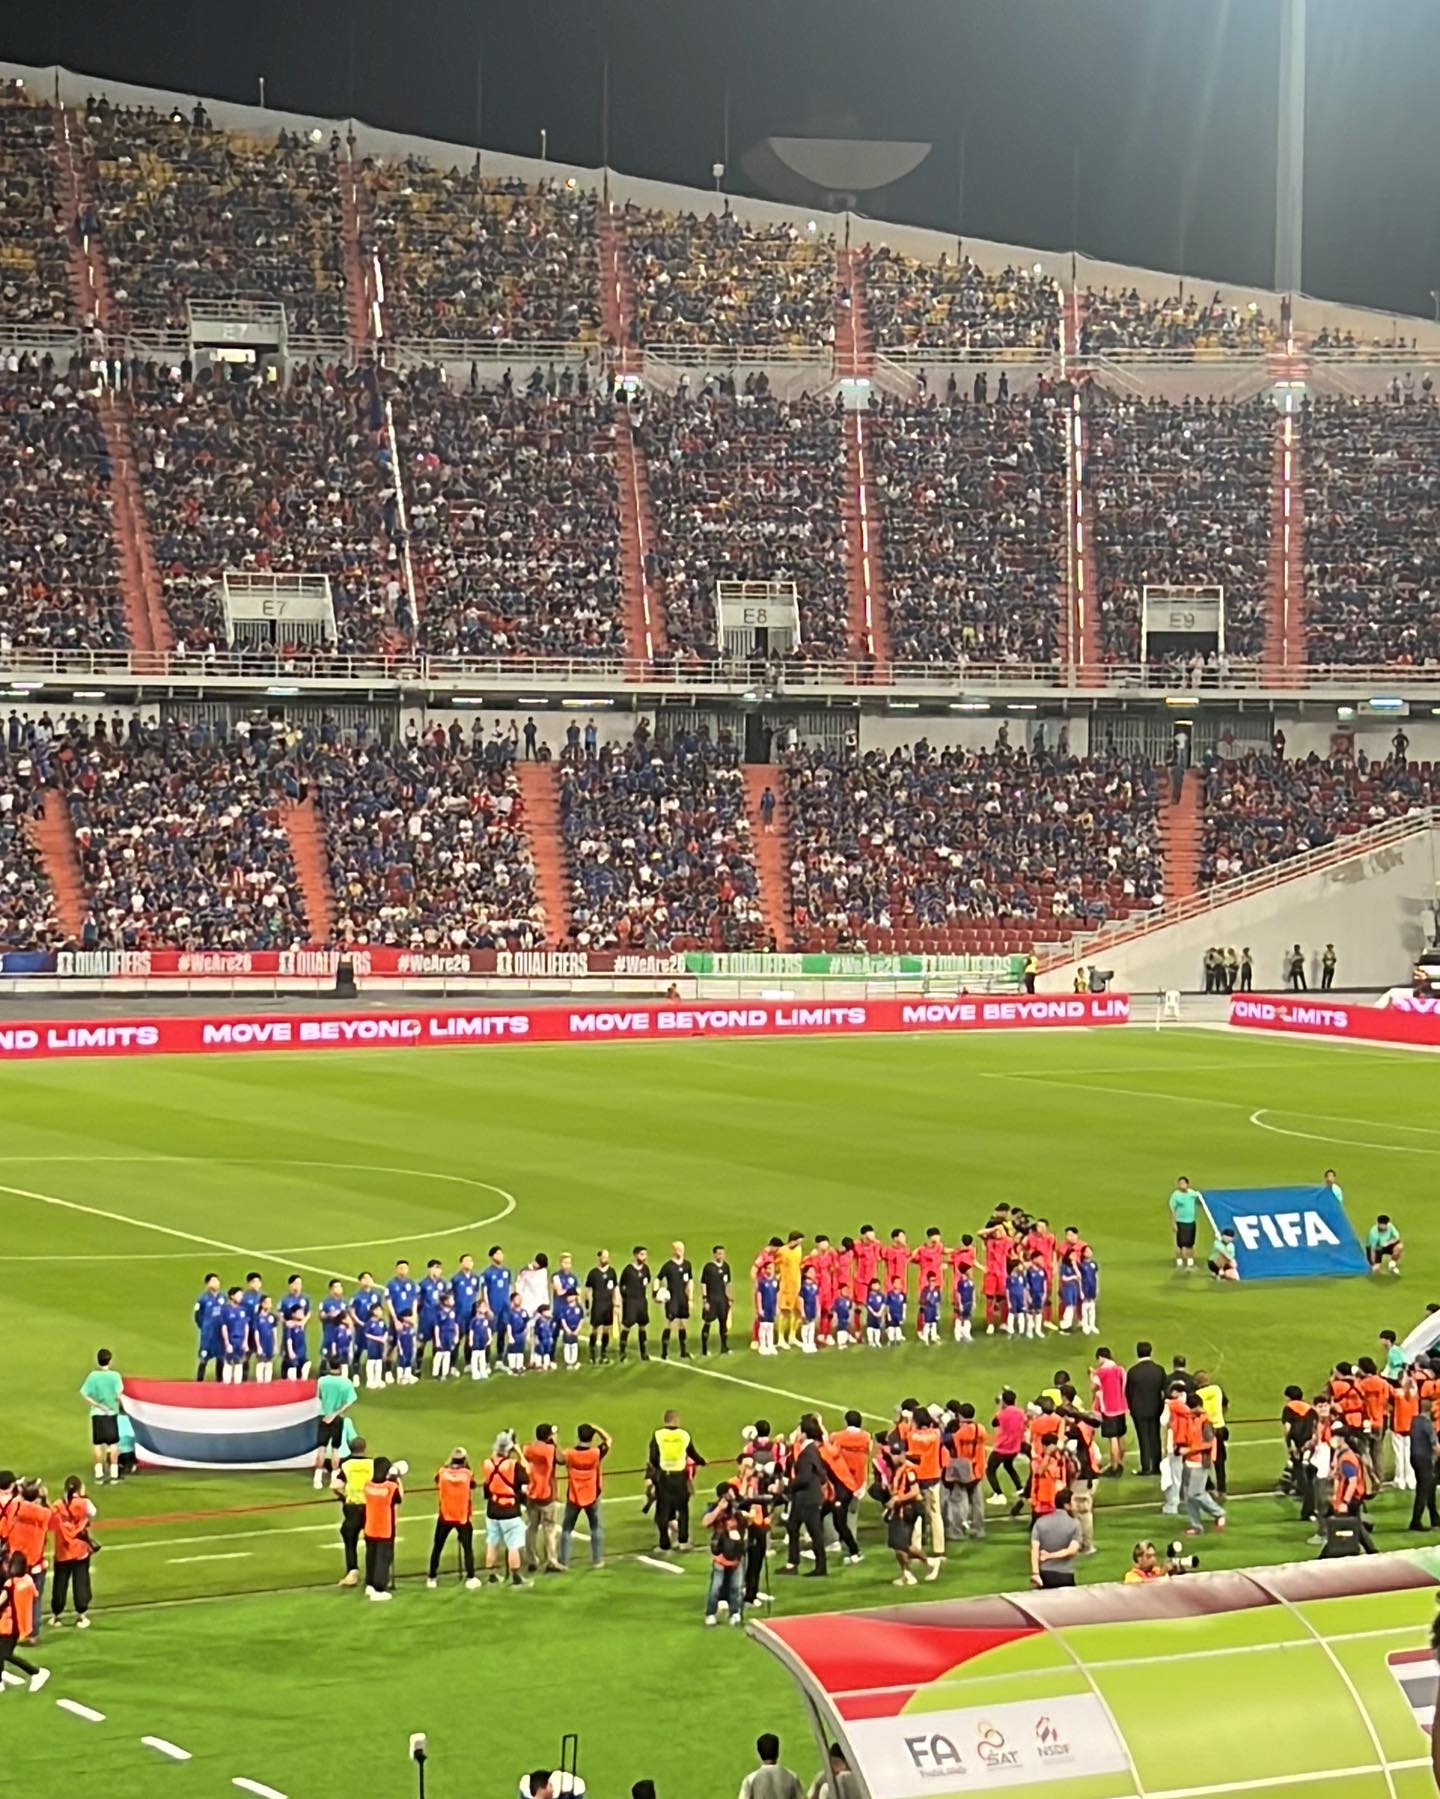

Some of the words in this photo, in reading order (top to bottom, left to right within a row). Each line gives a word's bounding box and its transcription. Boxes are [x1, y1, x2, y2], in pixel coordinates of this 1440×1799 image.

[262, 600, 287, 616] E7
[743, 608, 768, 625] E8
[1169, 612, 1195, 630] E9
[75, 951, 151, 976] QUALIFIERS
[398, 953, 470, 973] #WeAre26
[514, 952, 588, 976] QUALIFIERS
[570, 1012, 649, 1032] MOVE
[657, 1009, 767, 1030] BEYOND
[775, 1007, 866, 1027] LIMITS
[903, 1004, 976, 1023] MOVE
[983, 1000, 1085, 1020] BEYOND
[47, 1026, 159, 1048] LIMITS
[203, 1022, 291, 1044] MOVE
[300, 1019, 421, 1041] BEYOND
[429, 1016, 529, 1037] LIMITS
[1233, 1211, 1340, 1249] FIFA
[904, 1734, 962, 1768] FA
[987, 1751, 1019, 1768] SAT
